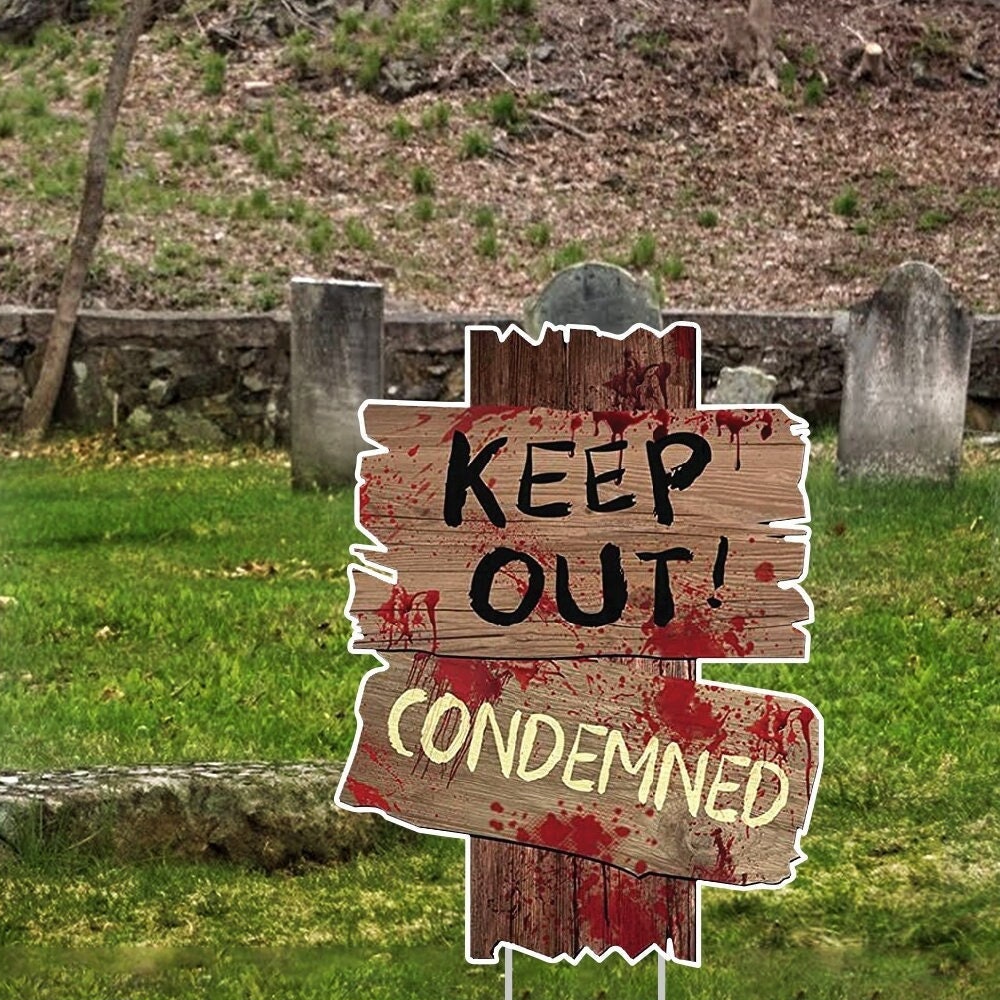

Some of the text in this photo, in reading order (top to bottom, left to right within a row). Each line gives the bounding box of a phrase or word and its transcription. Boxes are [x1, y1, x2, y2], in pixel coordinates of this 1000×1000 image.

[442, 429, 712, 529] KEEP
[468, 535, 728, 629] OUT!
[386, 687, 791, 828] CONDEMNED
